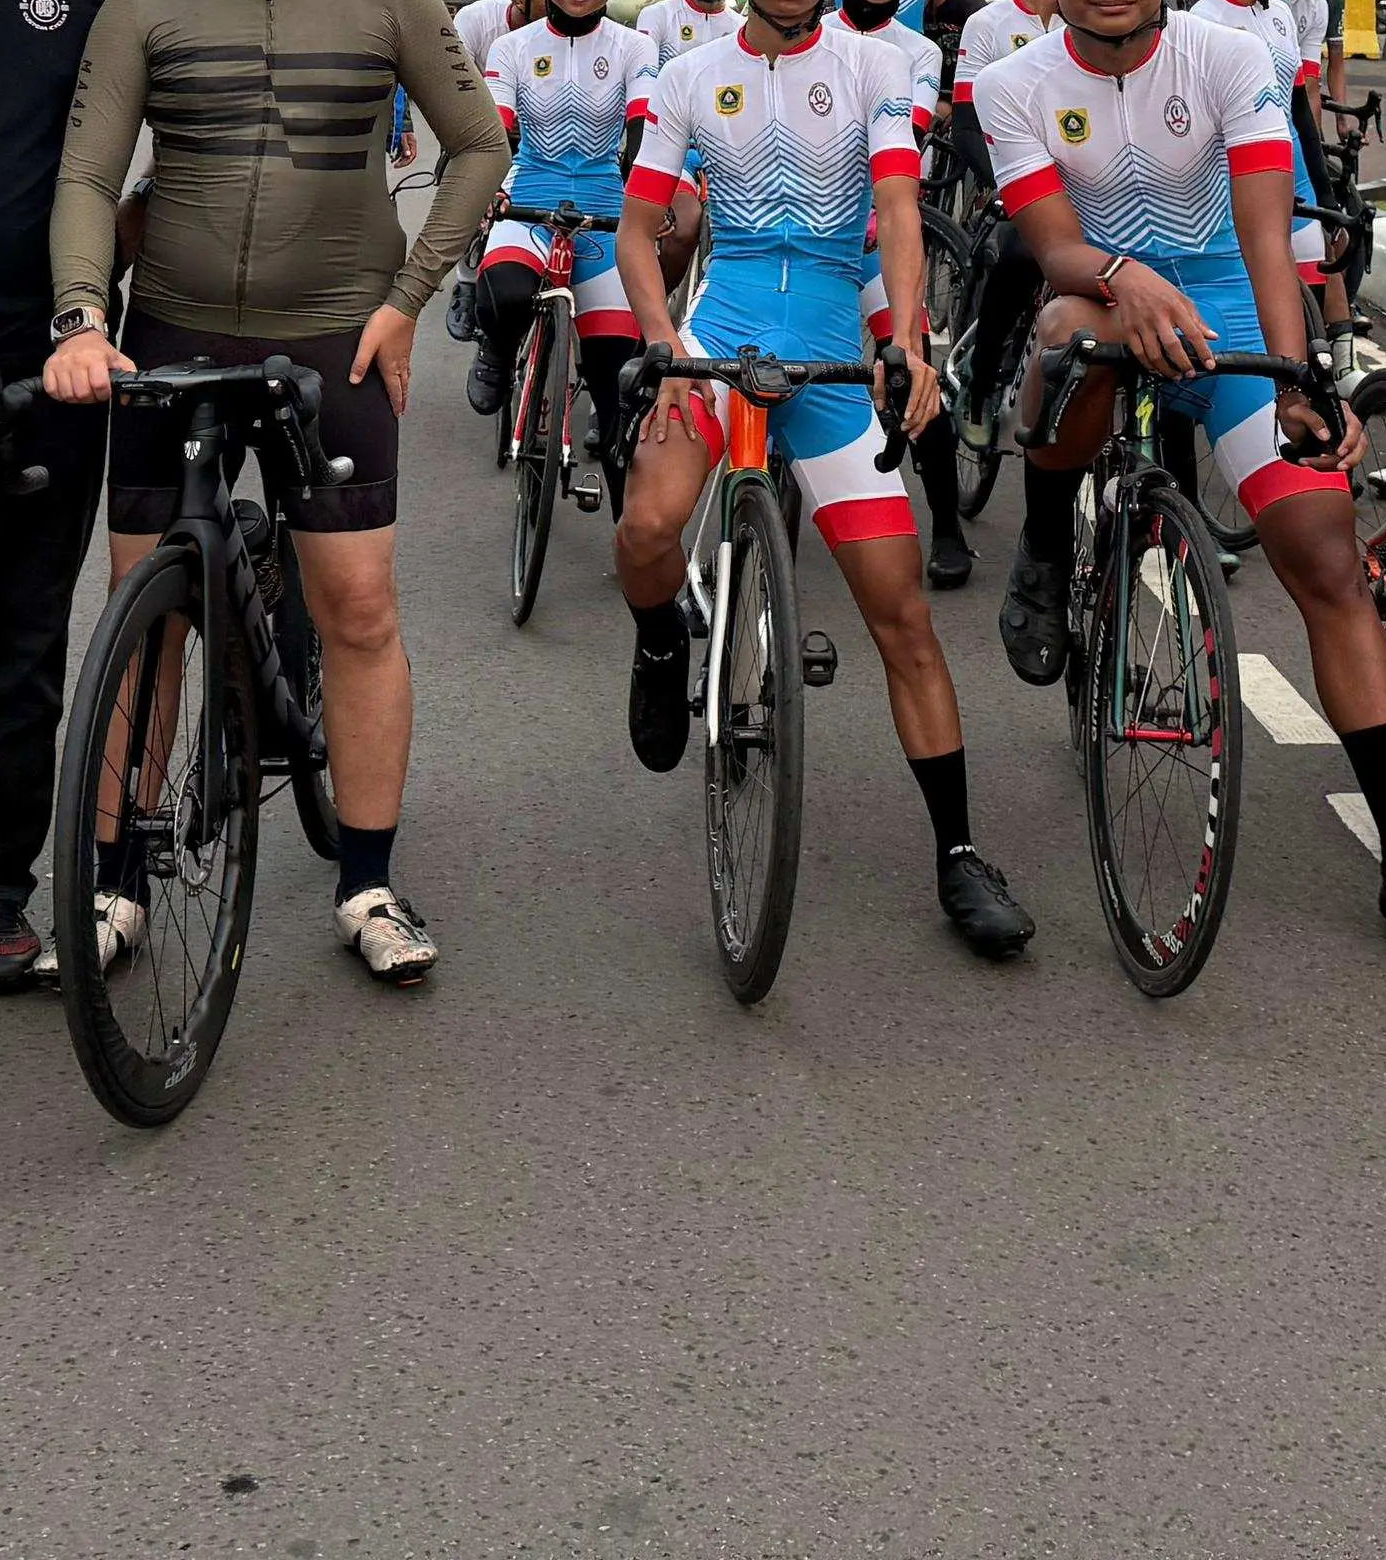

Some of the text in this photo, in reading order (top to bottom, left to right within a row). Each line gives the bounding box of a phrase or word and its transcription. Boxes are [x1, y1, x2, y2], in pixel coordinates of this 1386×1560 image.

[439, 26, 478, 92] MAAP
[71, 60, 93, 128] MAAP
[1092, 620, 1105, 742] american
